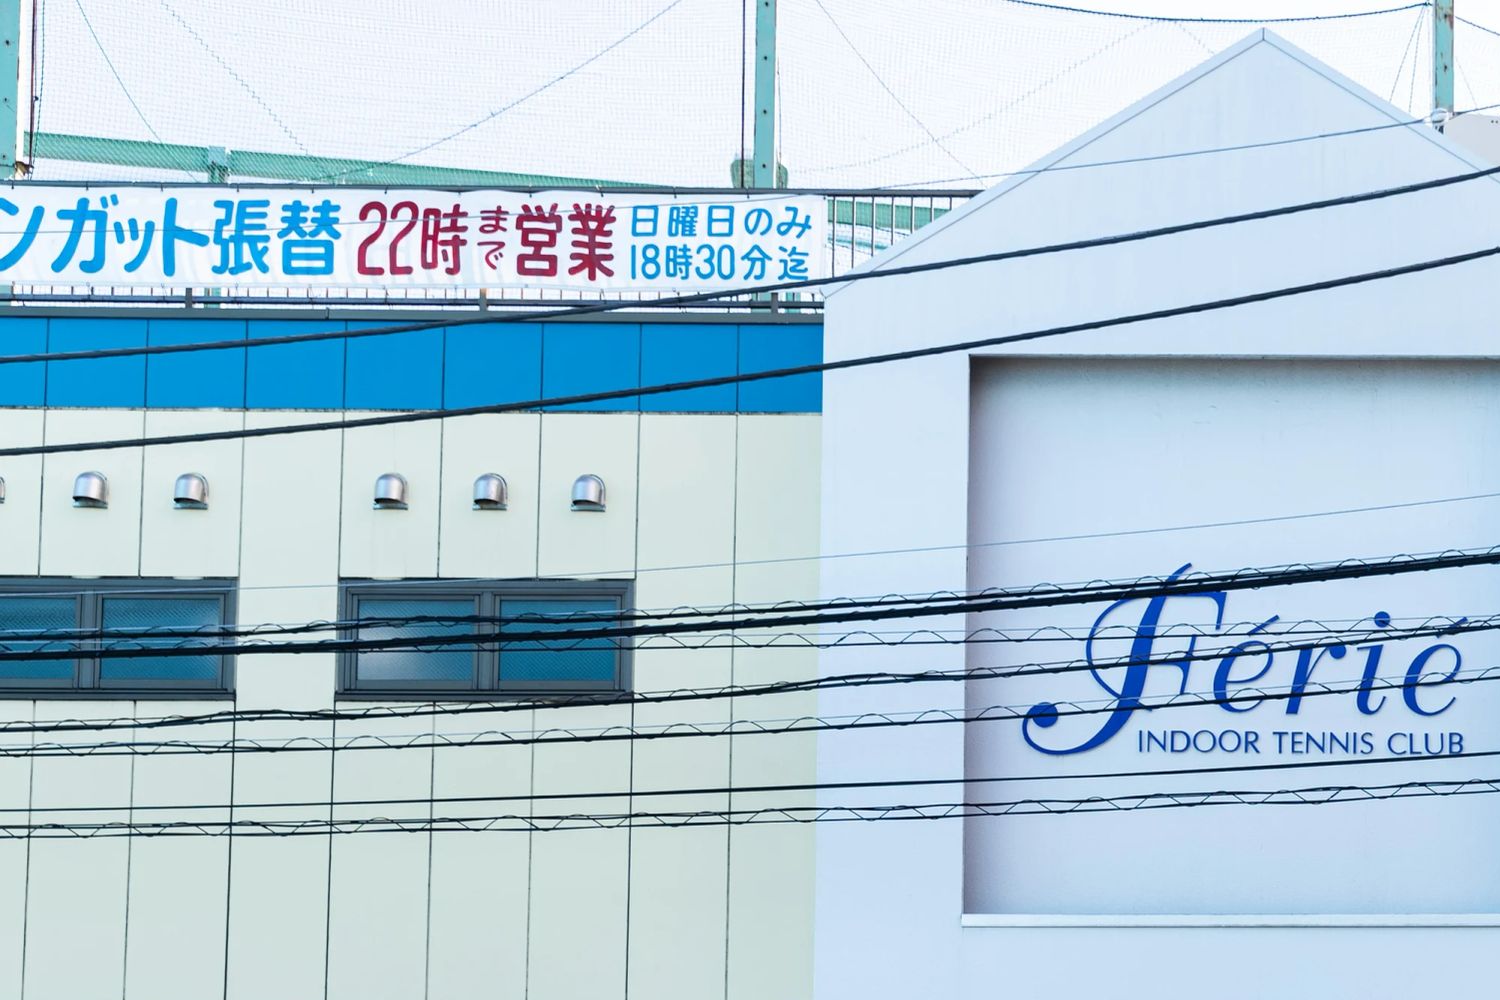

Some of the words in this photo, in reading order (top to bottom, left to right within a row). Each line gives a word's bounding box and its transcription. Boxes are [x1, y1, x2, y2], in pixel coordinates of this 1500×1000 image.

[631, 204, 812, 238] 日曜日のみ
[358, 200, 617, 282] 22時まで営業
[630, 243, 810, 281] 18時30分迄
[1022, 562, 1468, 756] Férié
[1138, 729, 1261, 754] INDOOR
[1272, 731, 1375, 755] TENNIS
[1387, 731, 1465, 756] CLUB
